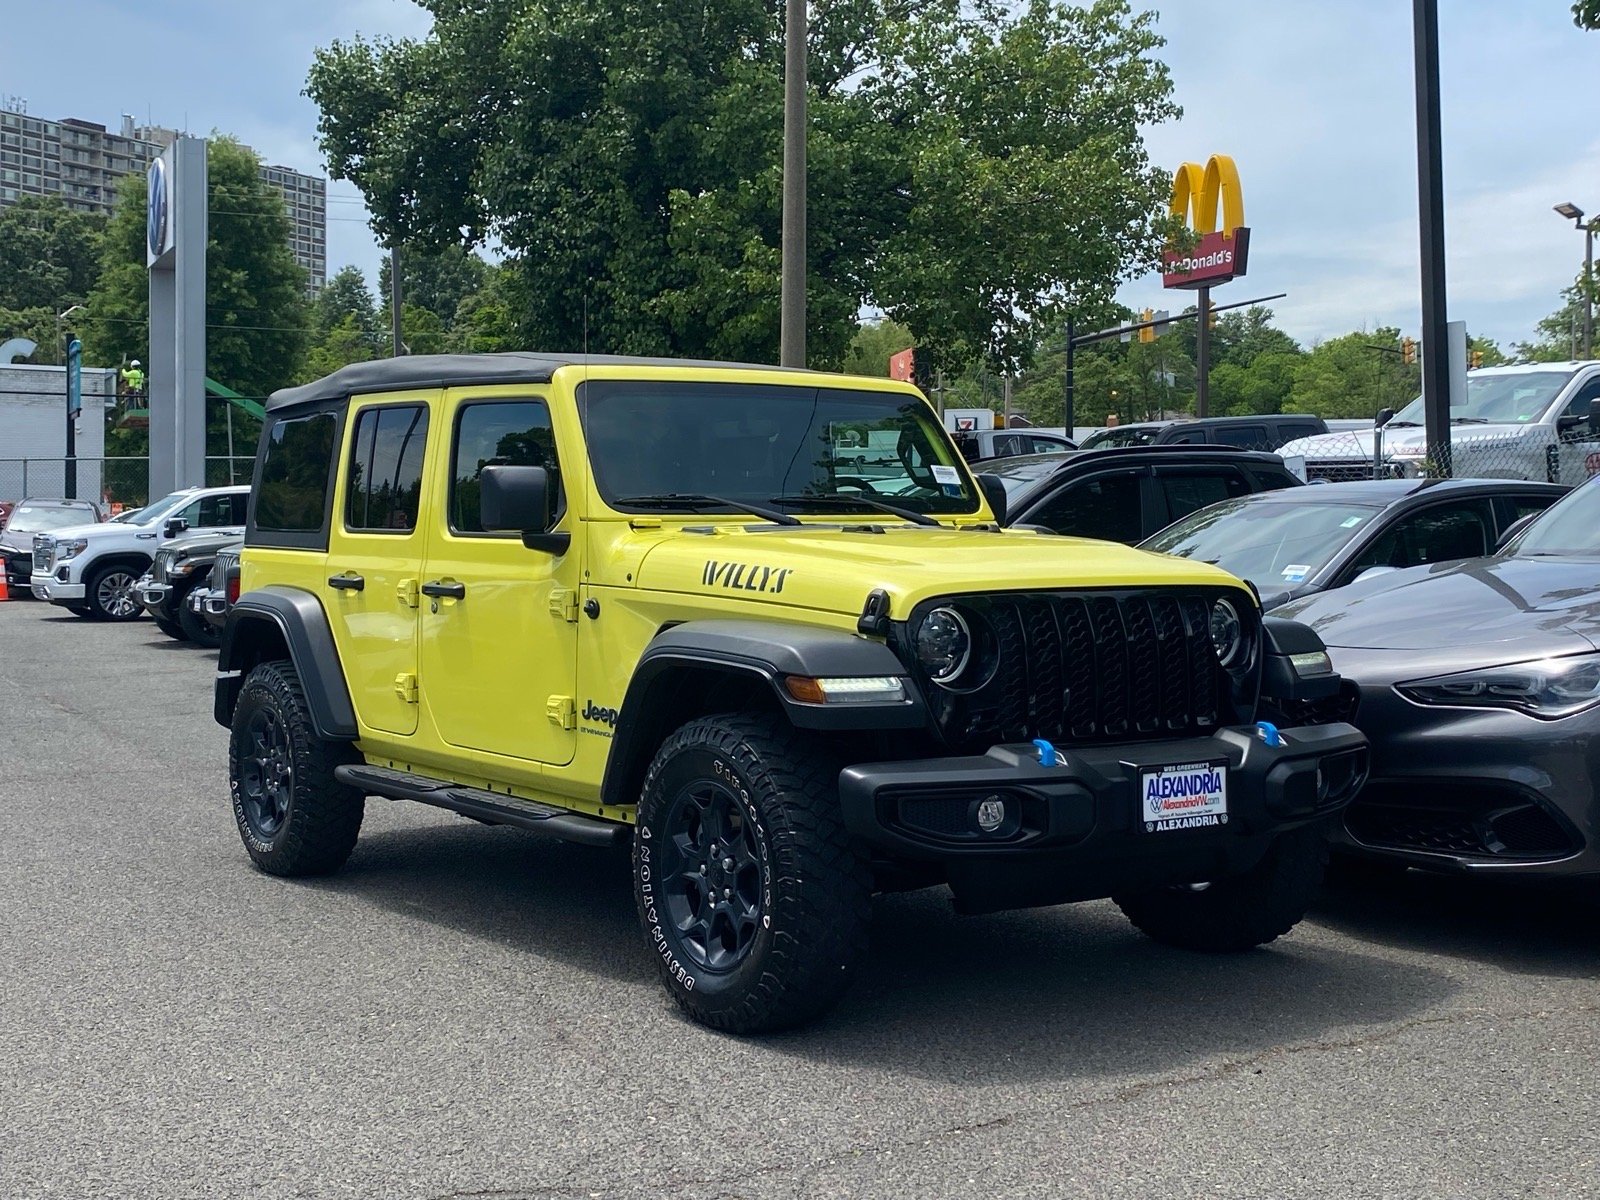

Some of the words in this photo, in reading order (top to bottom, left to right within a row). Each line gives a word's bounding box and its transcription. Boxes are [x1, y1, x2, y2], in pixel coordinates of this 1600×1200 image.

[702, 560, 793, 593] WILLYS
[581, 699, 618, 728] Jeep
[1146, 772, 1222, 800] ALEXANDRIA
[1162, 795, 1220, 810] AlexandriaVW.com
[1156, 815, 1219, 831] ALEXANDRIA
[640, 845, 695, 991] DESTINATION
